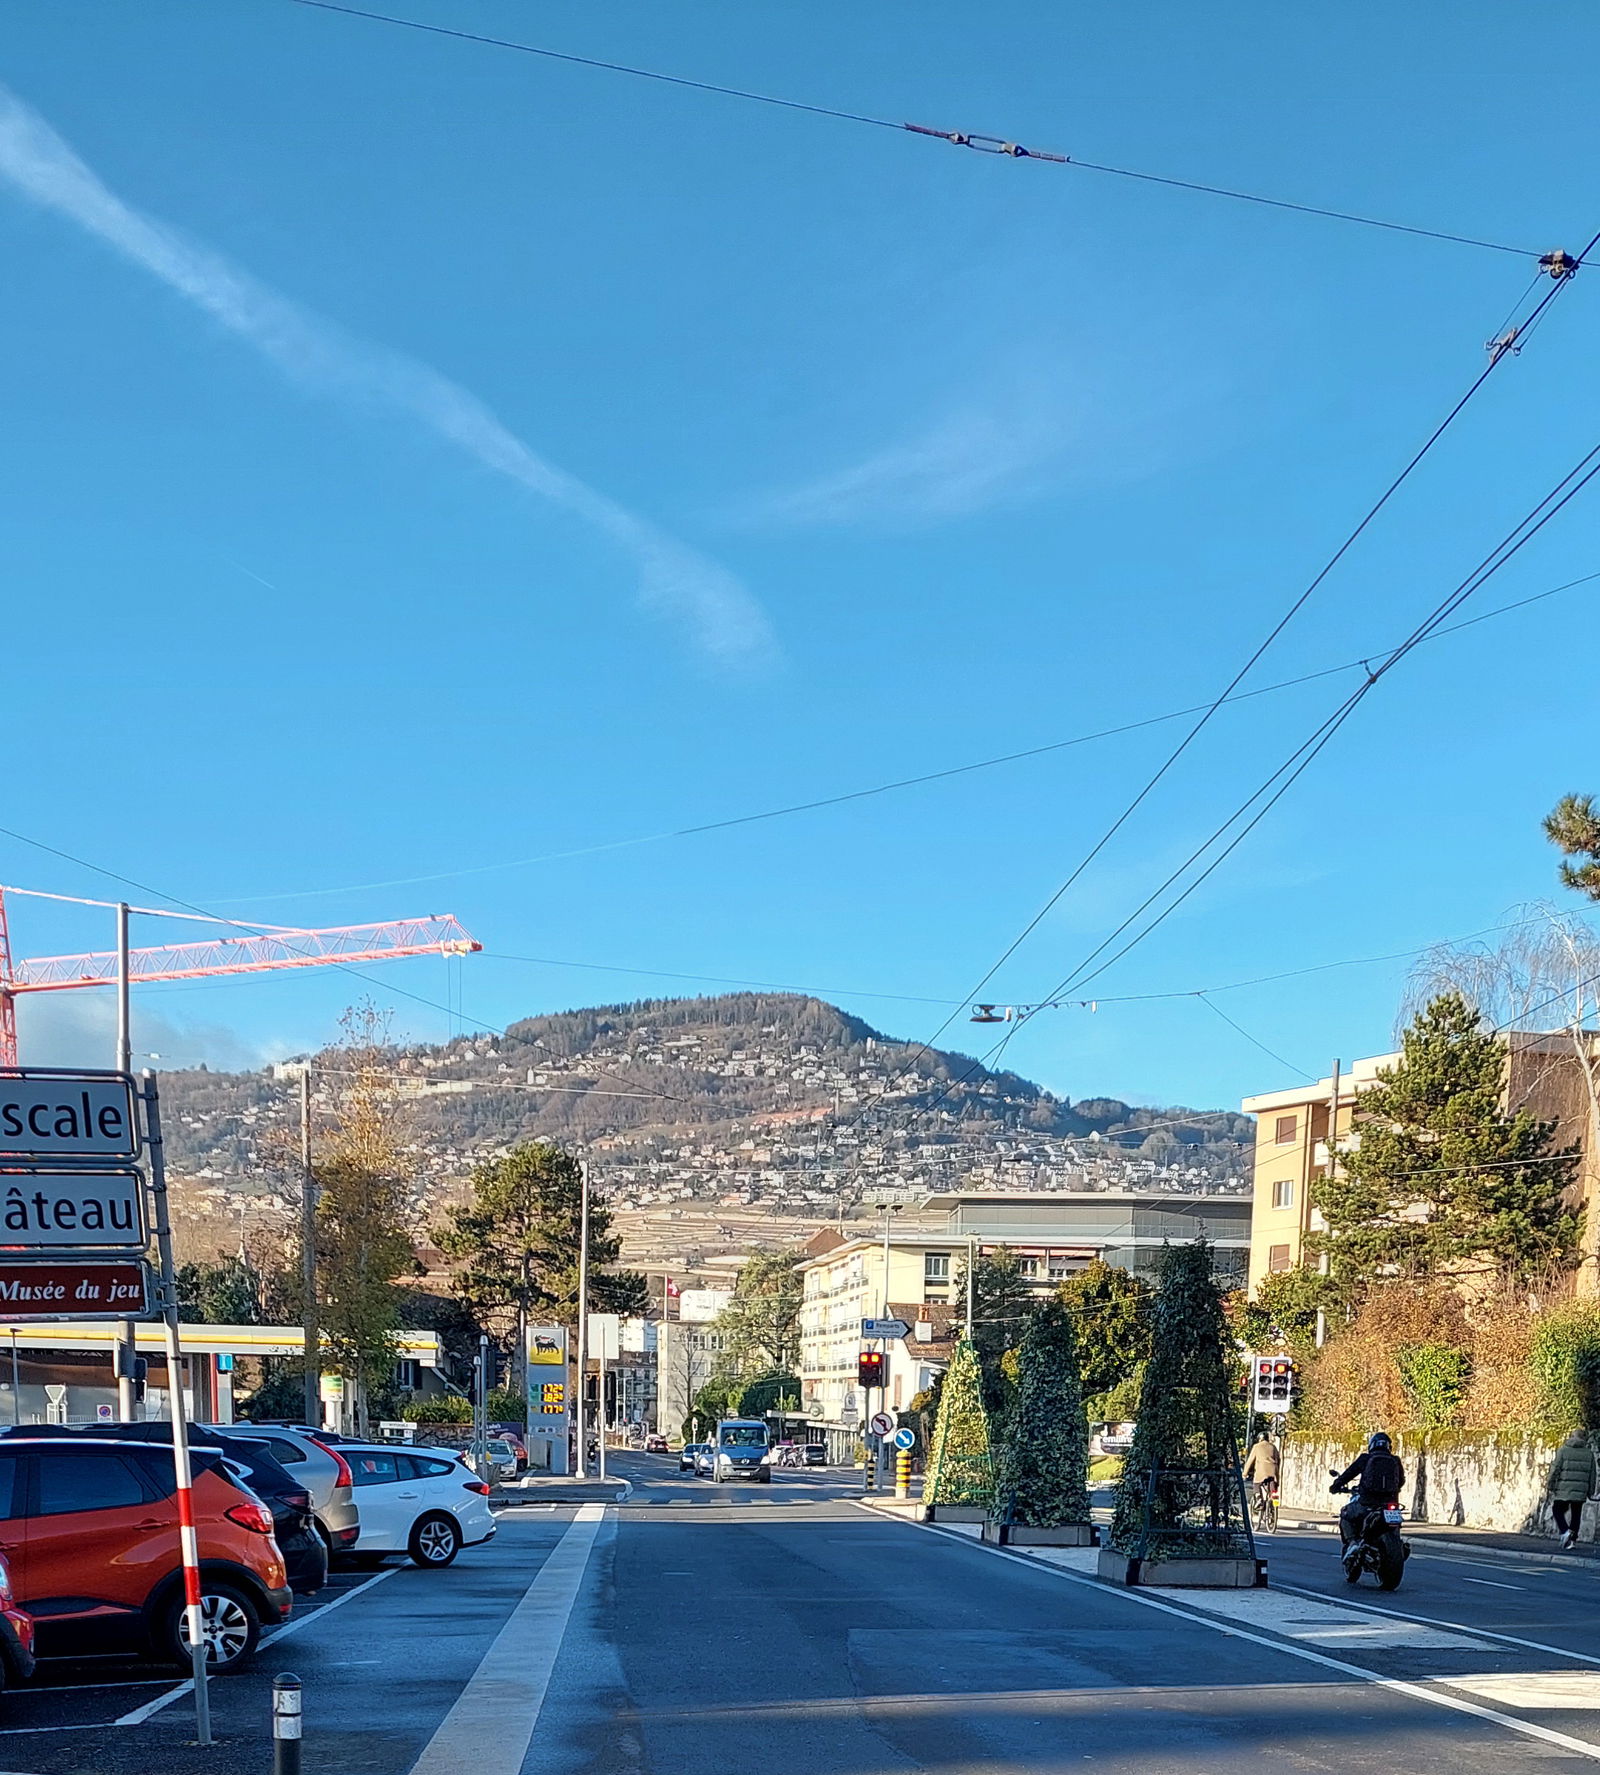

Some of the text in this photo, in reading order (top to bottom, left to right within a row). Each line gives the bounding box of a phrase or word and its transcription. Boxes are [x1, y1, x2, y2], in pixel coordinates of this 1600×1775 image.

[1, 1091, 123, 1139] scale
[4, 1187, 134, 1230] âteau
[0, 1278, 141, 1302] Musée du jeu
